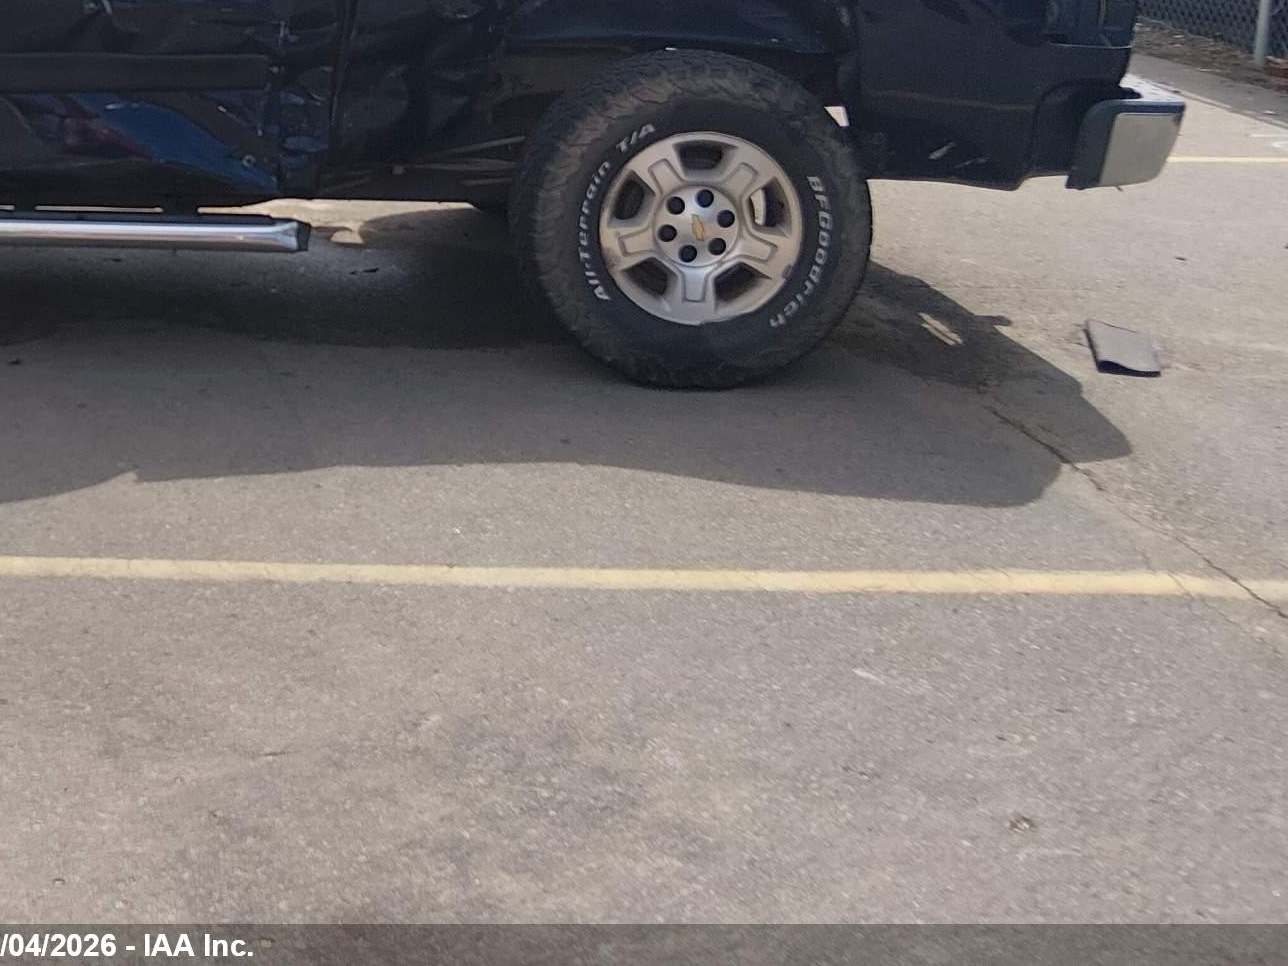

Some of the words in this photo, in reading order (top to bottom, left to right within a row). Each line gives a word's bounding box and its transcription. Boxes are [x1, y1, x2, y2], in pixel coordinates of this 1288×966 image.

[578, 160, 612, 301] All-Terrain
[616, 123, 656, 153] T/A
[768, 175, 834, 328] BFGoodrich
